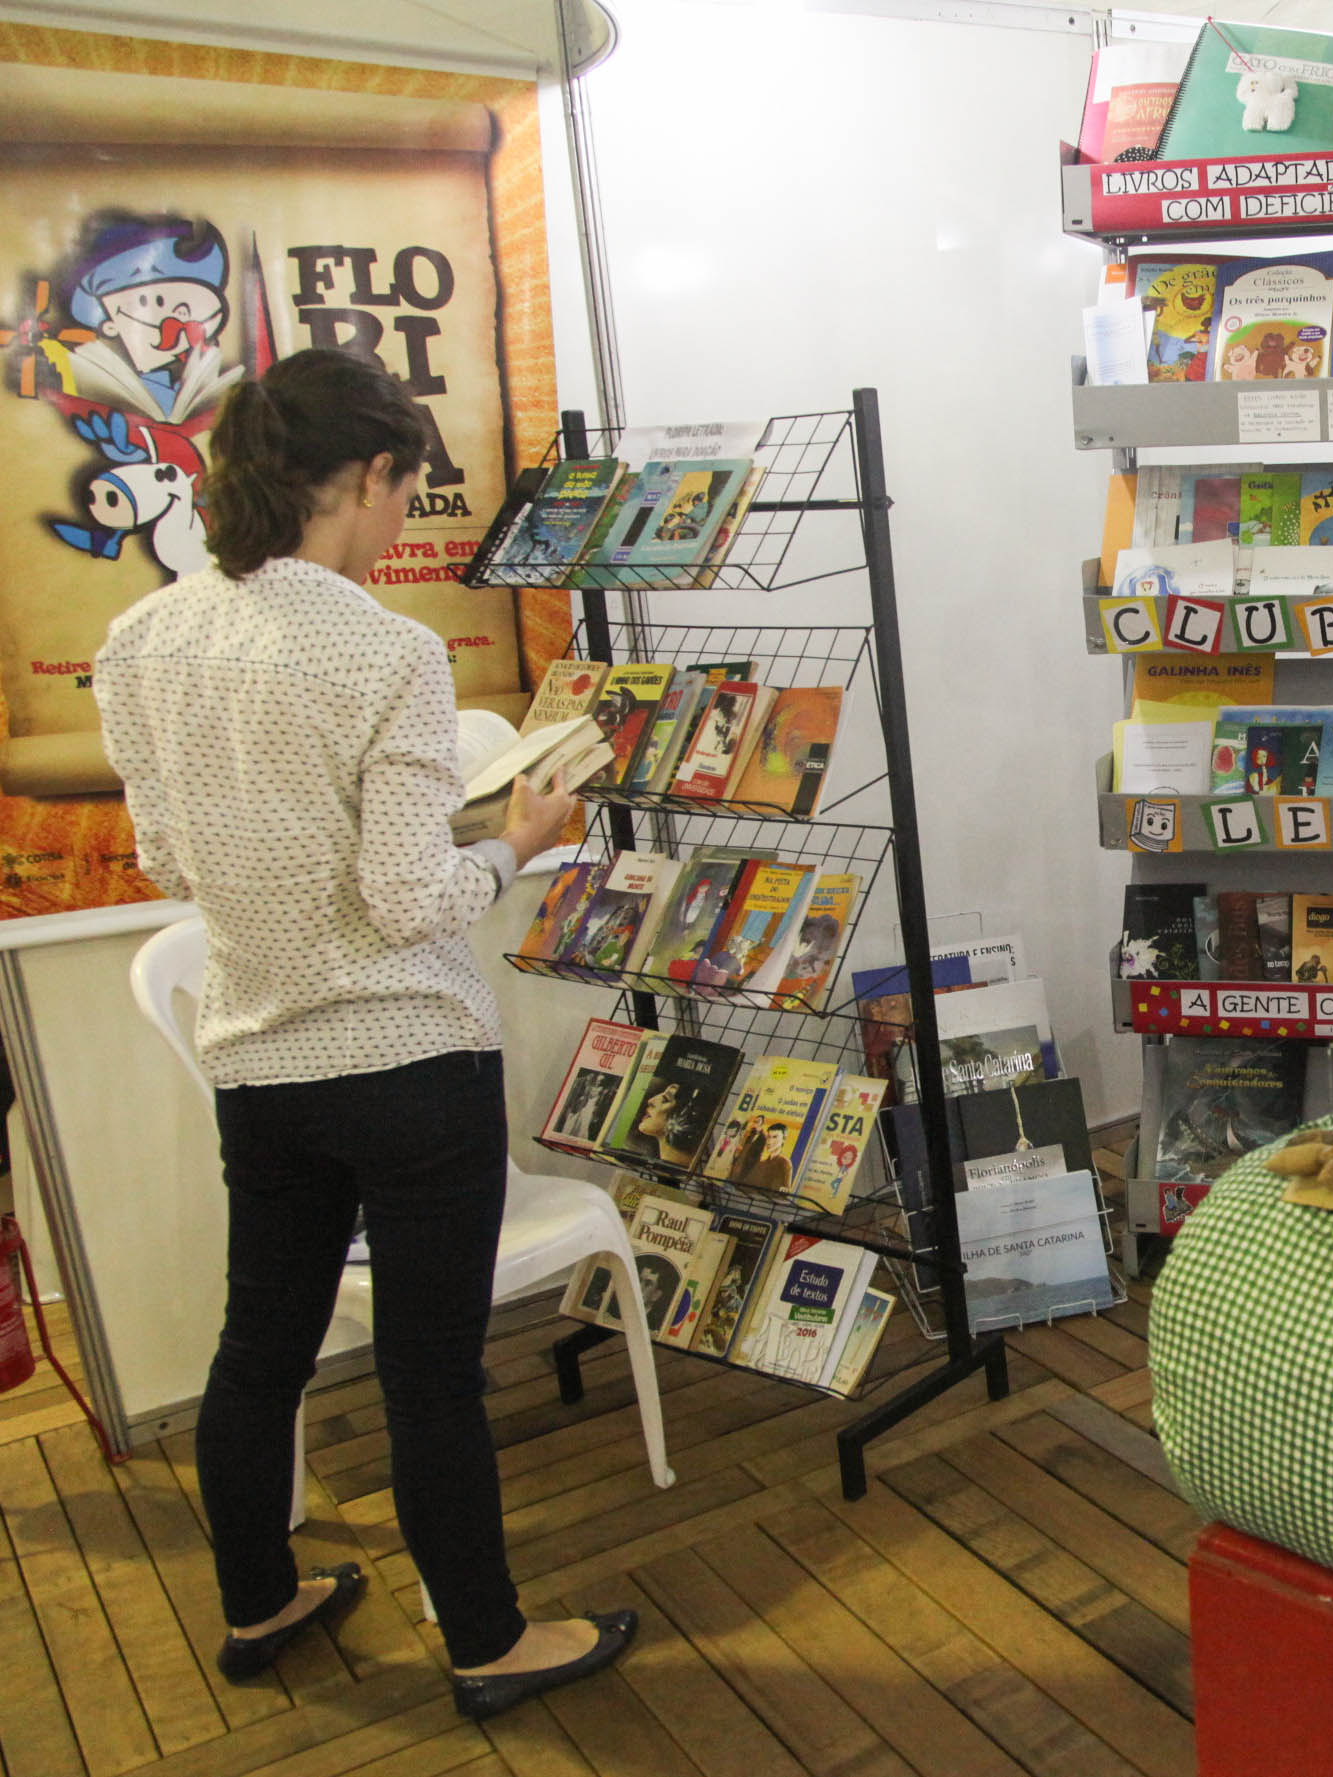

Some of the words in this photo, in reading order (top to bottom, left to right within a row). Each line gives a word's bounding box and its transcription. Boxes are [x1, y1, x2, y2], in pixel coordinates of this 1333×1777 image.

[1105, 167, 1193, 195] LIVROS
[1166, 196, 1230, 221] COM
[287, 245, 455, 311] FLO
[1253, 276, 1305, 287] Clássicos
[1244, 295, 1265, 305] três
[406, 492, 473, 519] ADA
[31, 660, 92, 676] Retire
[1147, 665, 1219, 677] GALINHA
[1226, 662, 1262, 677] INÊS
[1188, 993, 1208, 1012] A
[1222, 994, 1301, 1014] GENTE
[592, 1034, 638, 1058] GILBERTO
[948, 1058, 984, 1083] Santa
[984, 1050, 1034, 1078] Catarina
[968, 1155, 1047, 1180] Florianópolis
[656, 1209, 689, 1234] Raul
[963, 1246, 987, 1261] ILHA
[988, 1246, 1002, 1257] DE
[1003, 1240, 1036, 1254] SANTA
[1037, 1231, 1086, 1248] CATARINA
[799, 1269, 829, 1288] Estudo
[790, 1284, 801, 1296] de
[802, 1287, 829, 1302] textos
[796, 1327, 818, 1339] 2016
